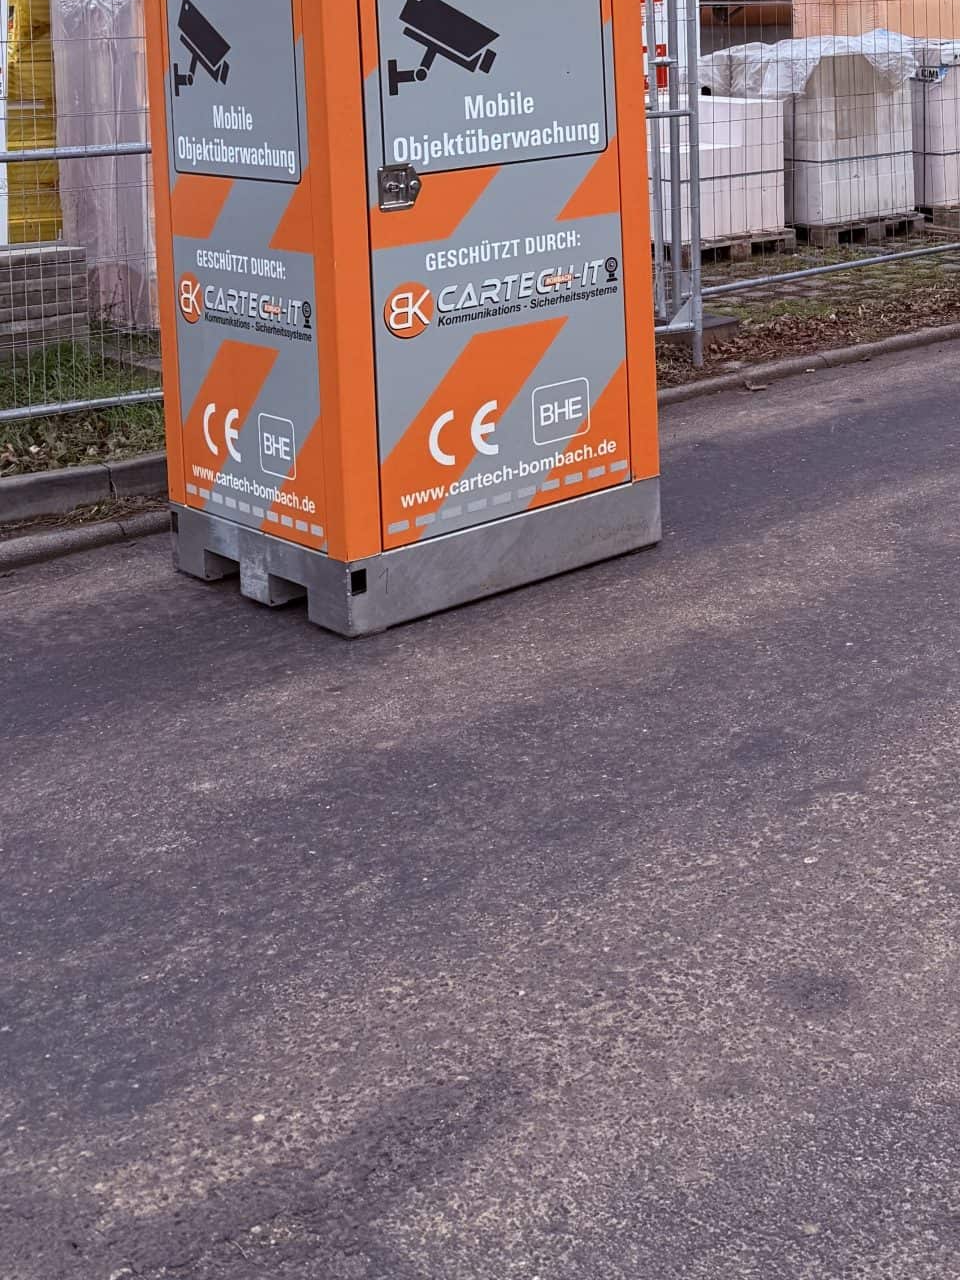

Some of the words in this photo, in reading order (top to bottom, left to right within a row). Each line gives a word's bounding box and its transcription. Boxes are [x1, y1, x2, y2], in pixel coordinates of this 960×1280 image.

[213, 105, 253, 131] Mobile
[464, 91, 534, 120] Mobile
[178, 134, 295, 174] Objektüberwachung
[393, 120, 600, 164] Objektüberwachung
[197, 250, 248, 274] GESCHÜTZT
[251, 257, 286, 280] DURCH:
[426, 239, 520, 271] GESCHÜTZT
[525, 230, 581, 255] DURCH:
[438, 304, 521, 327] Kommunikations
[530, 285, 618, 309] Sicherheitssysteme
[205, 313, 250, 330] Kommunikations
[255, 322, 312, 342] Sicherheitssysteme
[540, 396, 582, 427] BHE
[263, 432, 291, 461] BHE
[192, 464, 316, 513] www.cartech-bombach.de
[401, 439, 617, 508] www.cartech-bombach.de
